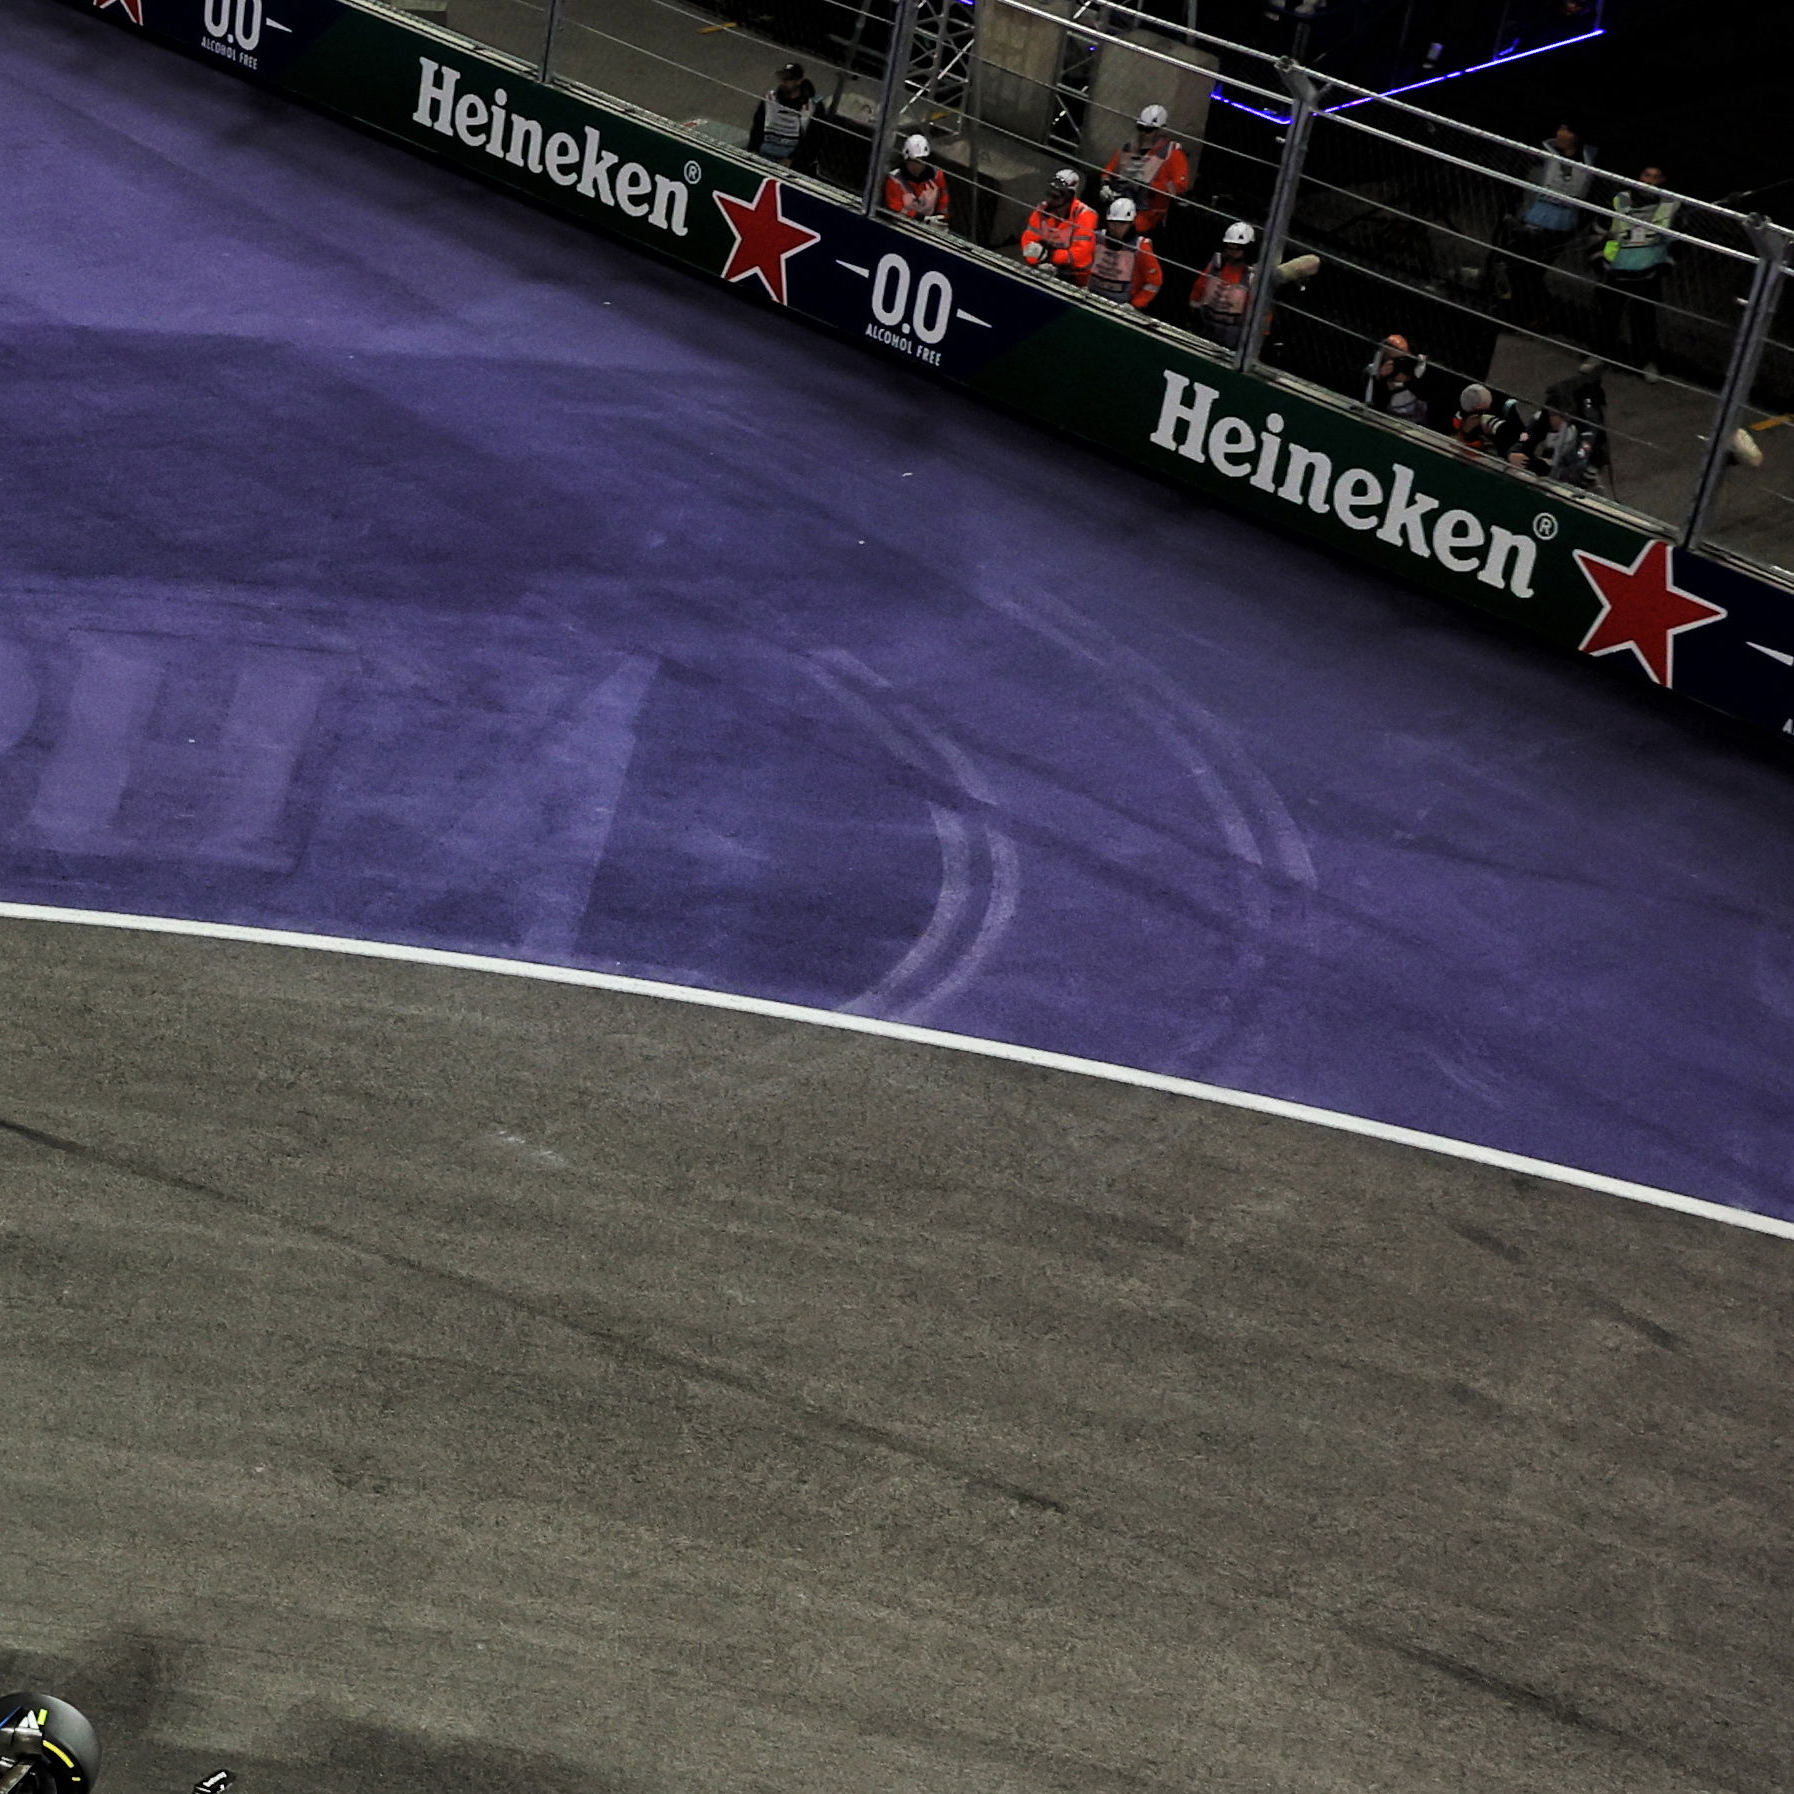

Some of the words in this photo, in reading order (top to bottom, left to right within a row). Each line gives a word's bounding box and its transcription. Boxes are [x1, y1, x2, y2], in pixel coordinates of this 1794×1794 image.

[201, 36, 236, 61] ALCOHOL
[239, 52, 258, 70] FREE
[413, 56, 689, 238] Heineken
[865, 323, 914, 355] ALCOHOL
[916, 345, 941, 367] FREE
[871, 252, 953, 345] 0.0
[1150, 368, 1538, 599] Heineken
